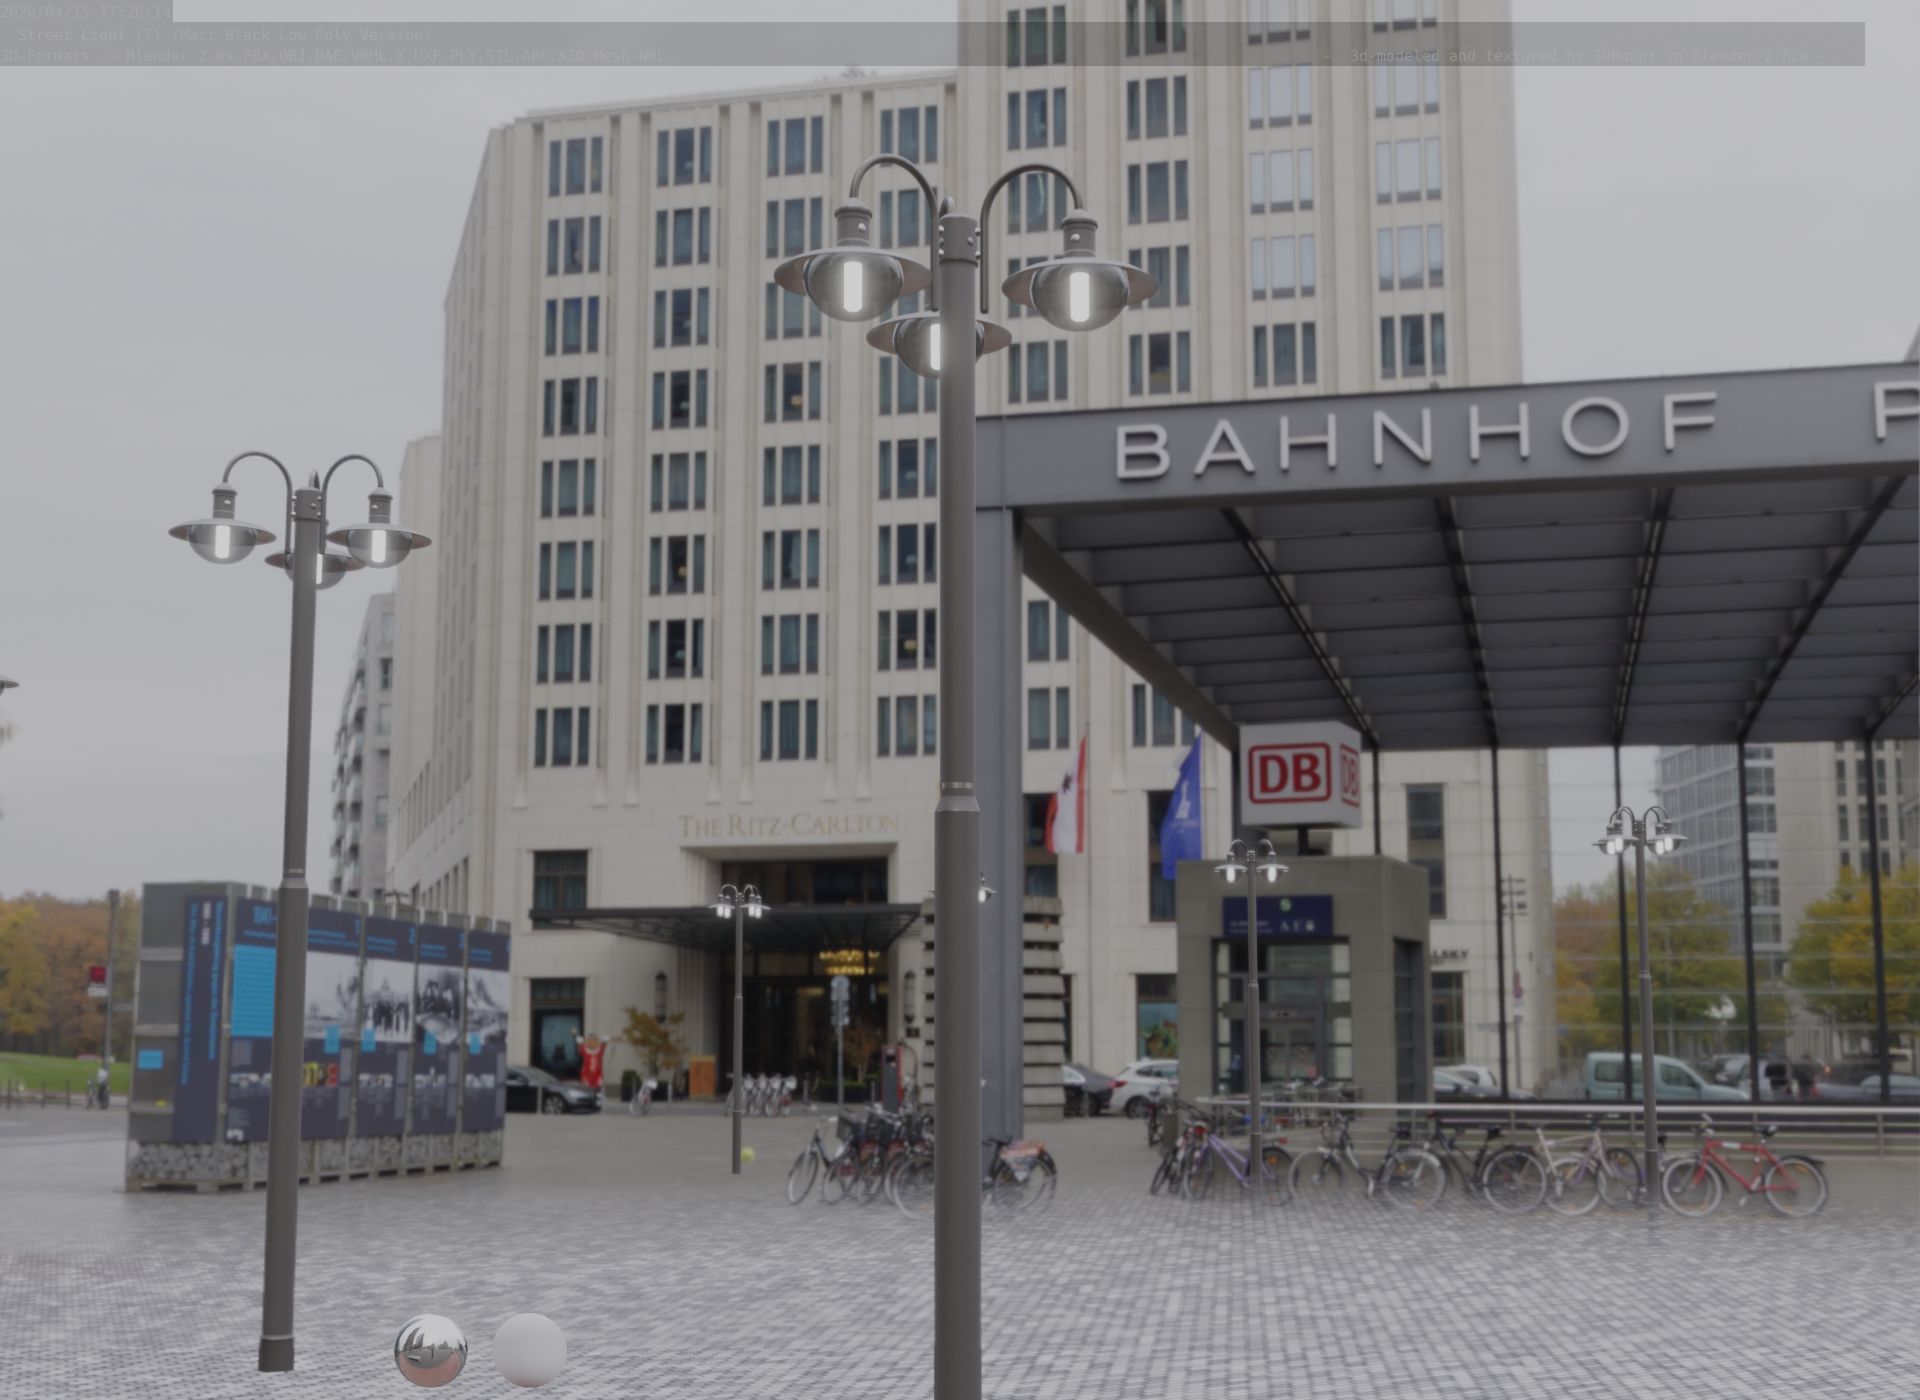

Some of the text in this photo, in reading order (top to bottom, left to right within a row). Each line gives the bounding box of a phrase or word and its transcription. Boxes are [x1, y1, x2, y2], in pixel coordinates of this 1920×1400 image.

[1116, 391, 1718, 481] BAHNHOF
[1260, 753, 1321, 794] DB
[1342, 756, 1359, 796] DB
[678, 815, 721, 838] THE
